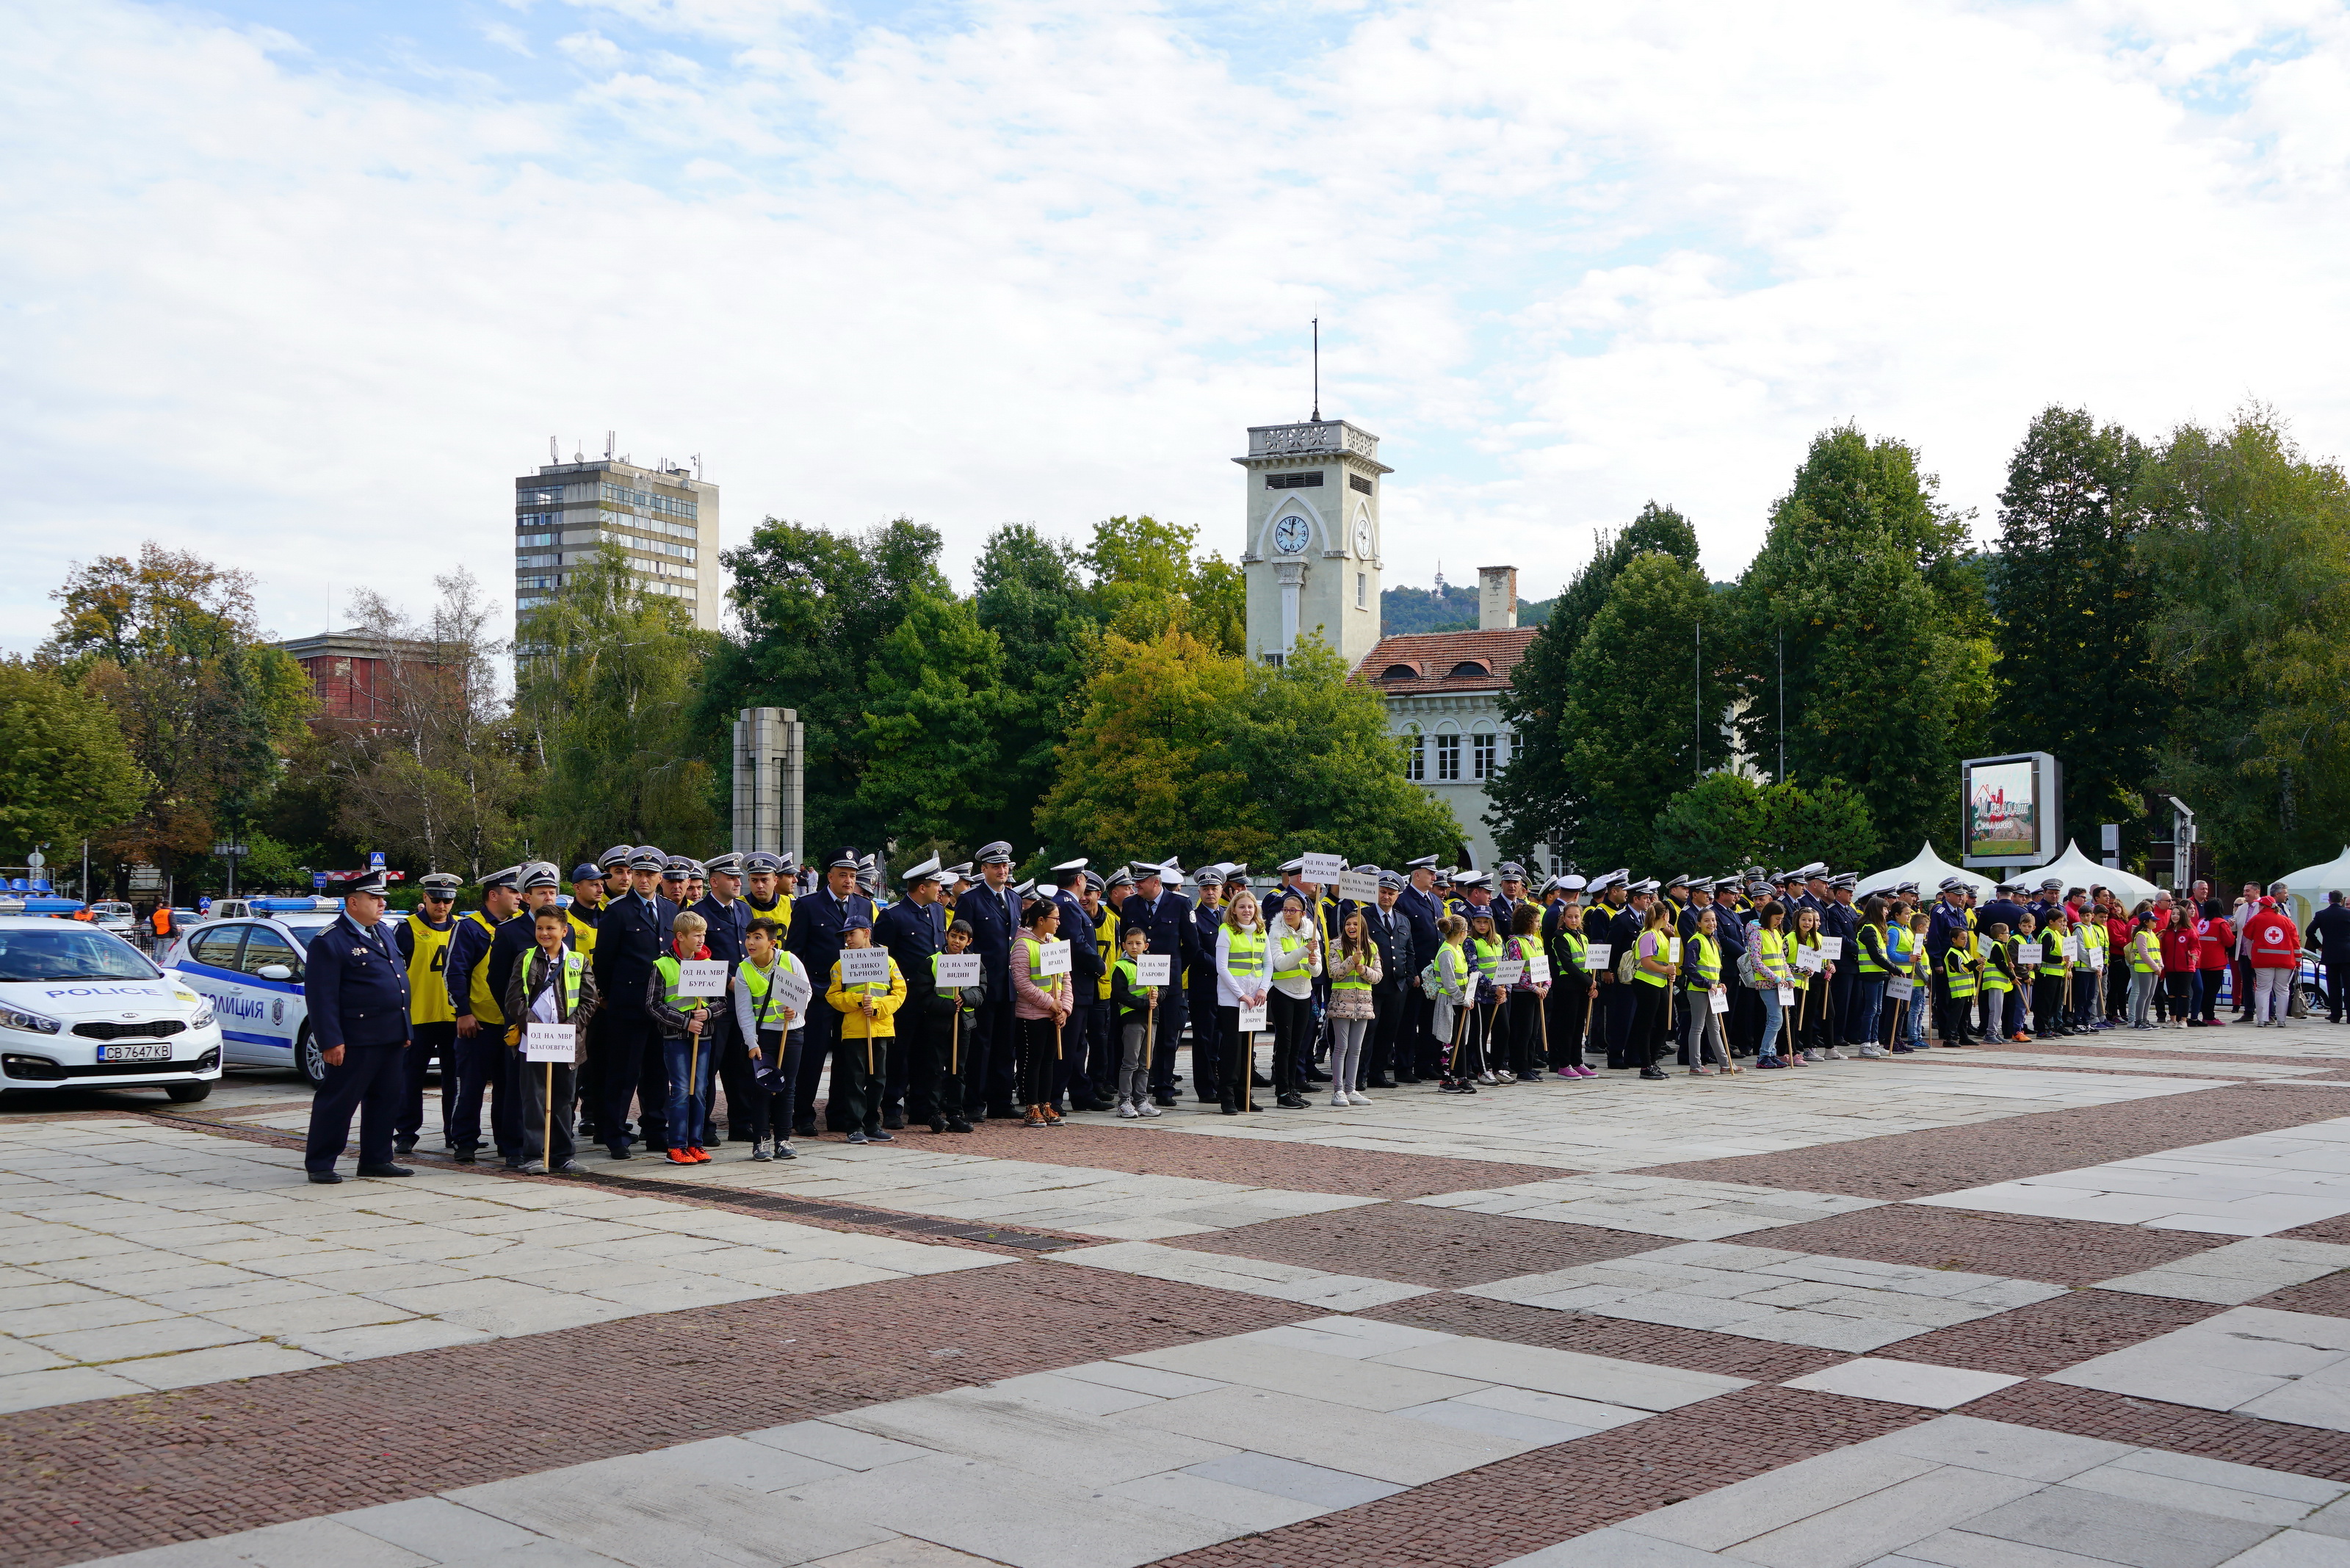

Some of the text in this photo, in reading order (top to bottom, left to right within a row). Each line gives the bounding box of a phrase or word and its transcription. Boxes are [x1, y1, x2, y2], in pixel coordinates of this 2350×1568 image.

[1342, 886, 1375, 895] КЮСТЕНДИЛ
[430, 944, 447, 972] 4
[776, 974, 806, 994] ОД НА МВР
[46, 988, 163, 999] POLICE
[780, 989, 798, 1002] ВАРНА
[107, 1046, 168, 1058] CB 7647 KB
